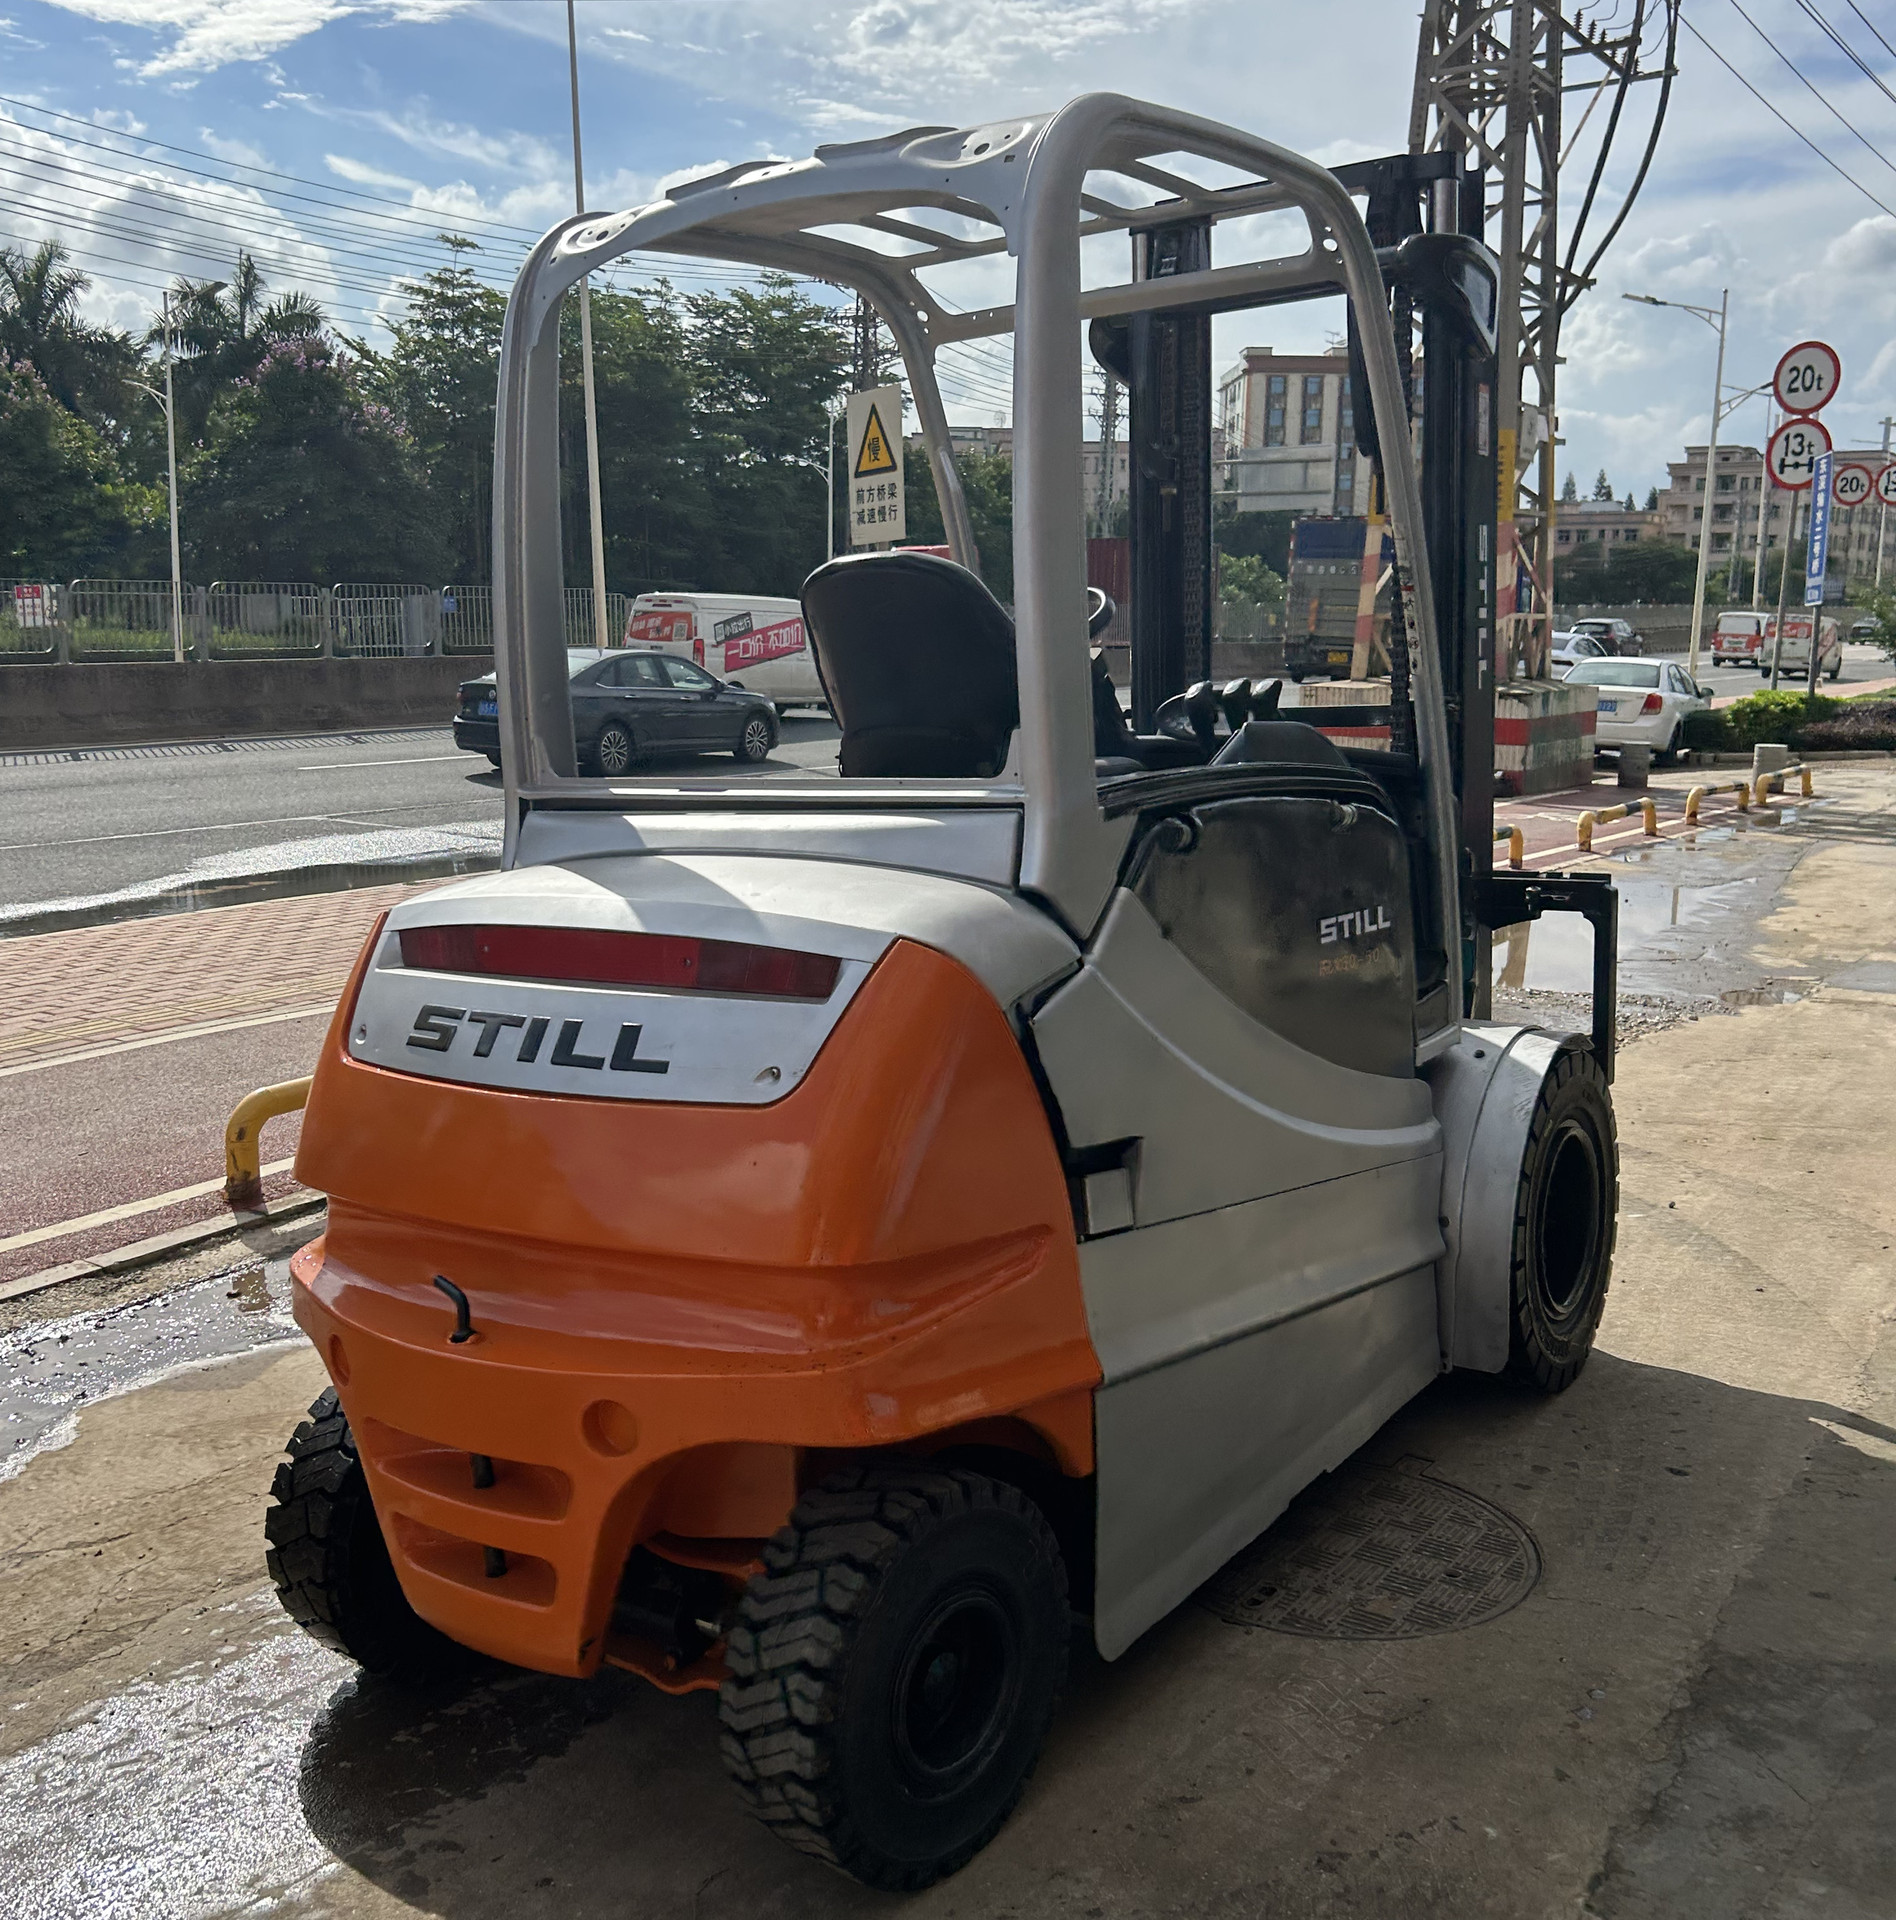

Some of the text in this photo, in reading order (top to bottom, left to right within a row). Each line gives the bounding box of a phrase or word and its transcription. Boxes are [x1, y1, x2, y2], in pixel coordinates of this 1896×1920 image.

[1787, 364, 1824, 394] 20t
[868, 437, 880, 462] 慢
[1784, 432, 1815, 457] 13t
[856, 482, 897, 504] 前方桥梁
[1839, 476, 1865, 493] 20t
[856, 504, 898, 526] 减速慢行
[1478, 524, 1488, 690] STILL
[727, 623, 802, 657] 一口价 不加价
[1320, 905, 1391, 944] STILL
[406, 1004, 670, 1074] STILL
